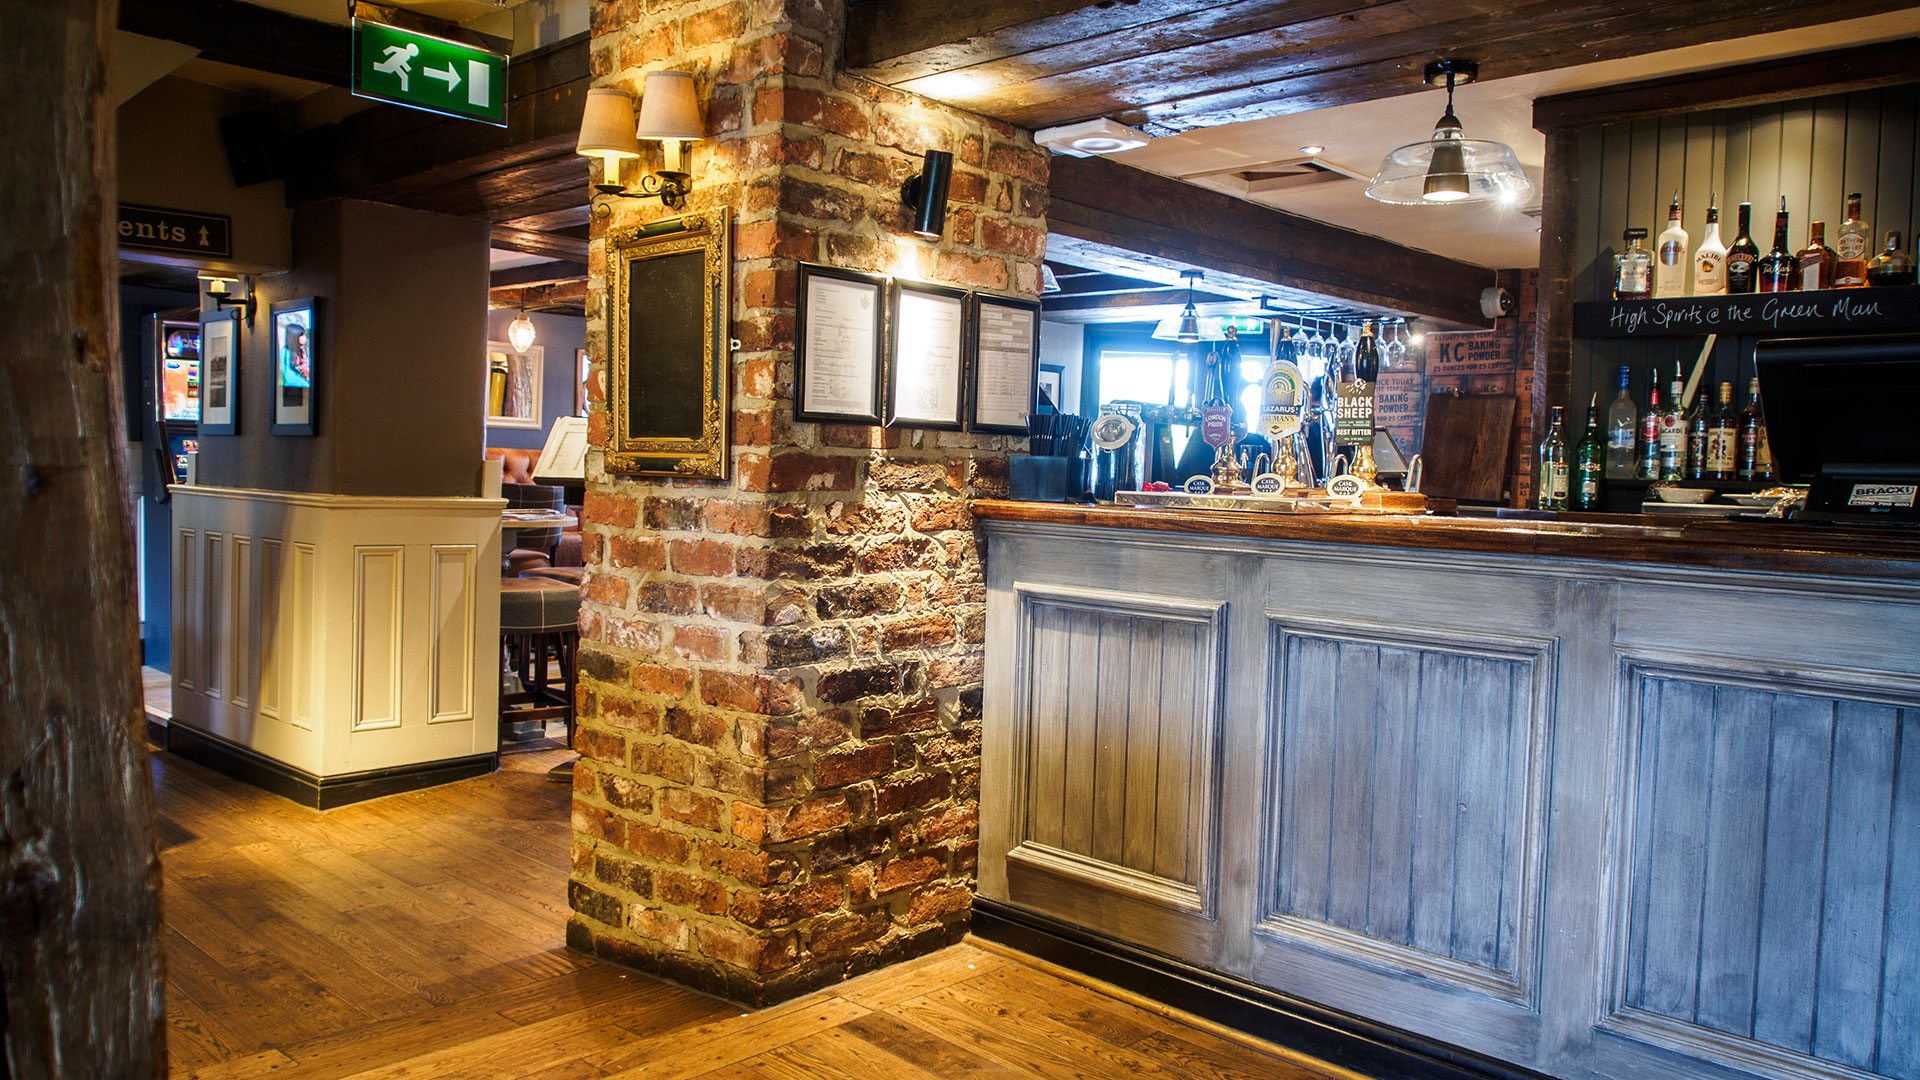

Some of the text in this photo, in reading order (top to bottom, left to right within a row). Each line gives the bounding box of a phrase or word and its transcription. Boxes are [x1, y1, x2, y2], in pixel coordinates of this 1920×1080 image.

[118, 220, 186, 242] ents
[1610, 306, 1649, 333] High
[1706, 307, 1720, 325] @
[1728, 304, 1753, 322] the
[1762, 298, 1824, 328] Green
[1832, 296, 1883, 321] Man
[182, 338, 200, 349] CAS
[1468, 339, 1501, 351] BAKING
[1468, 350, 1501, 361] POWDER
[1433, 365, 1441, 373] 25
[1442, 364, 1465, 372] OUNCES
[1391, 377, 1415, 386] TODAY
[1337, 396, 1373, 408] BLACK
[1379, 393, 1409, 403] BAKING
[1337, 408, 1373, 418] SHEEP
[1378, 404, 1409, 413] POWDER
[1205, 414, 1226, 423] LONDON
[1336, 428, 1372, 436] BEST BITTER
